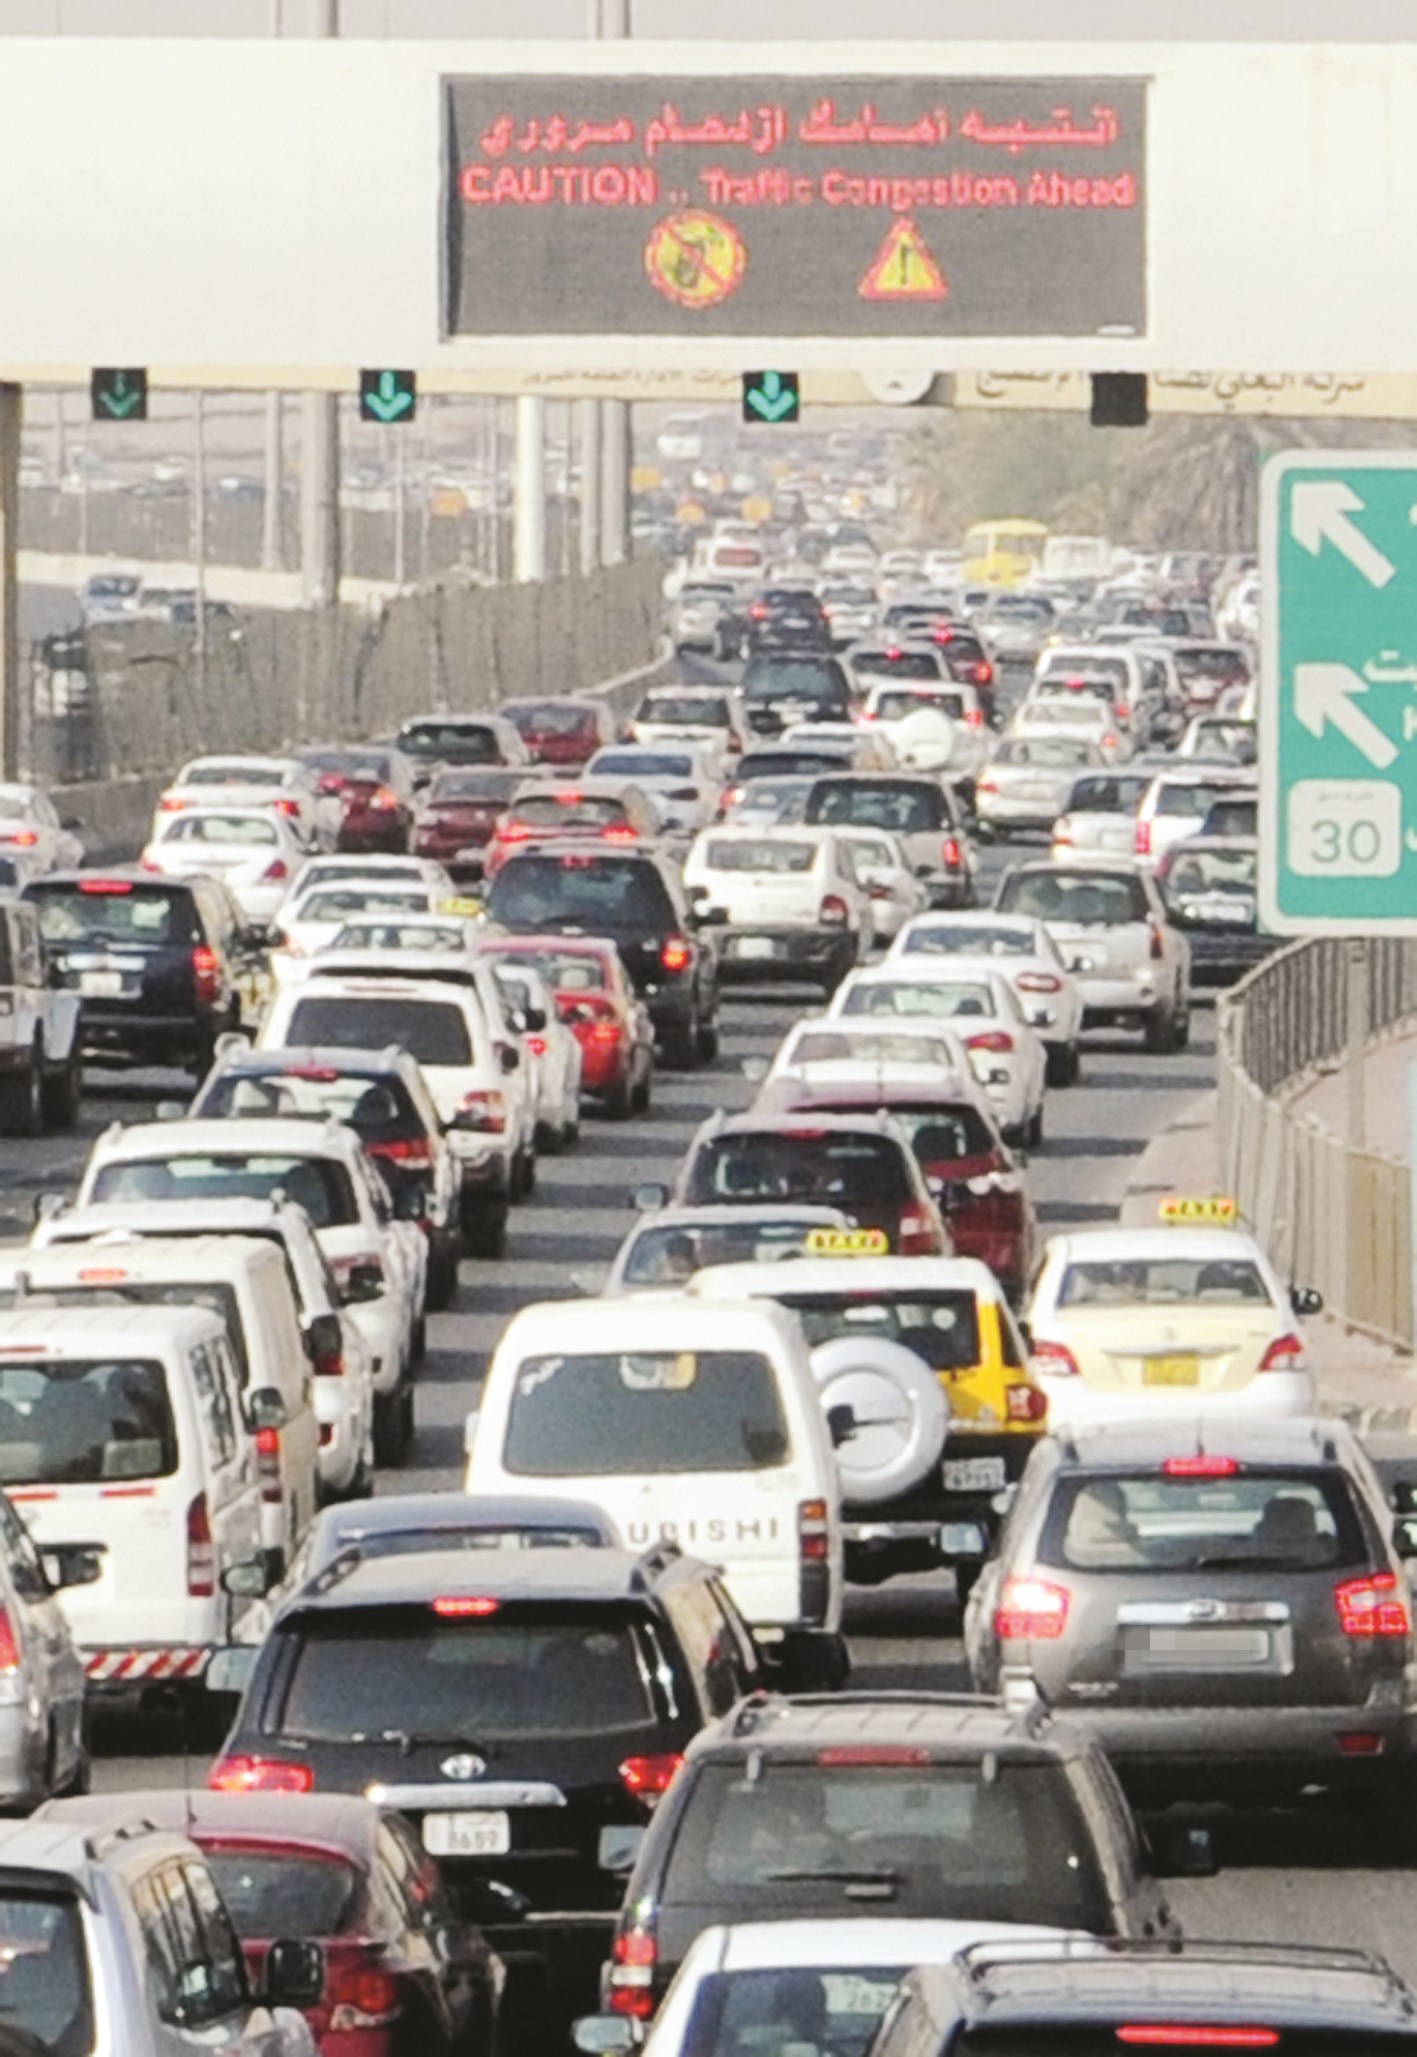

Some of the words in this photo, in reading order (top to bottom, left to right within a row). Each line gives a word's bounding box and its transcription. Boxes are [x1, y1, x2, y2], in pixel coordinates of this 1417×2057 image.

[480, 112, 637, 158] مروري
[461, 165, 660, 207] CAUTION
[701, 166, 813, 207] Traffic
[821, 168, 1021, 212] Congestion
[1026, 169, 1137, 208] Ahead
[1310, 819, 1382, 864] 30
[628, 1519, 779, 1544] UBISHI
